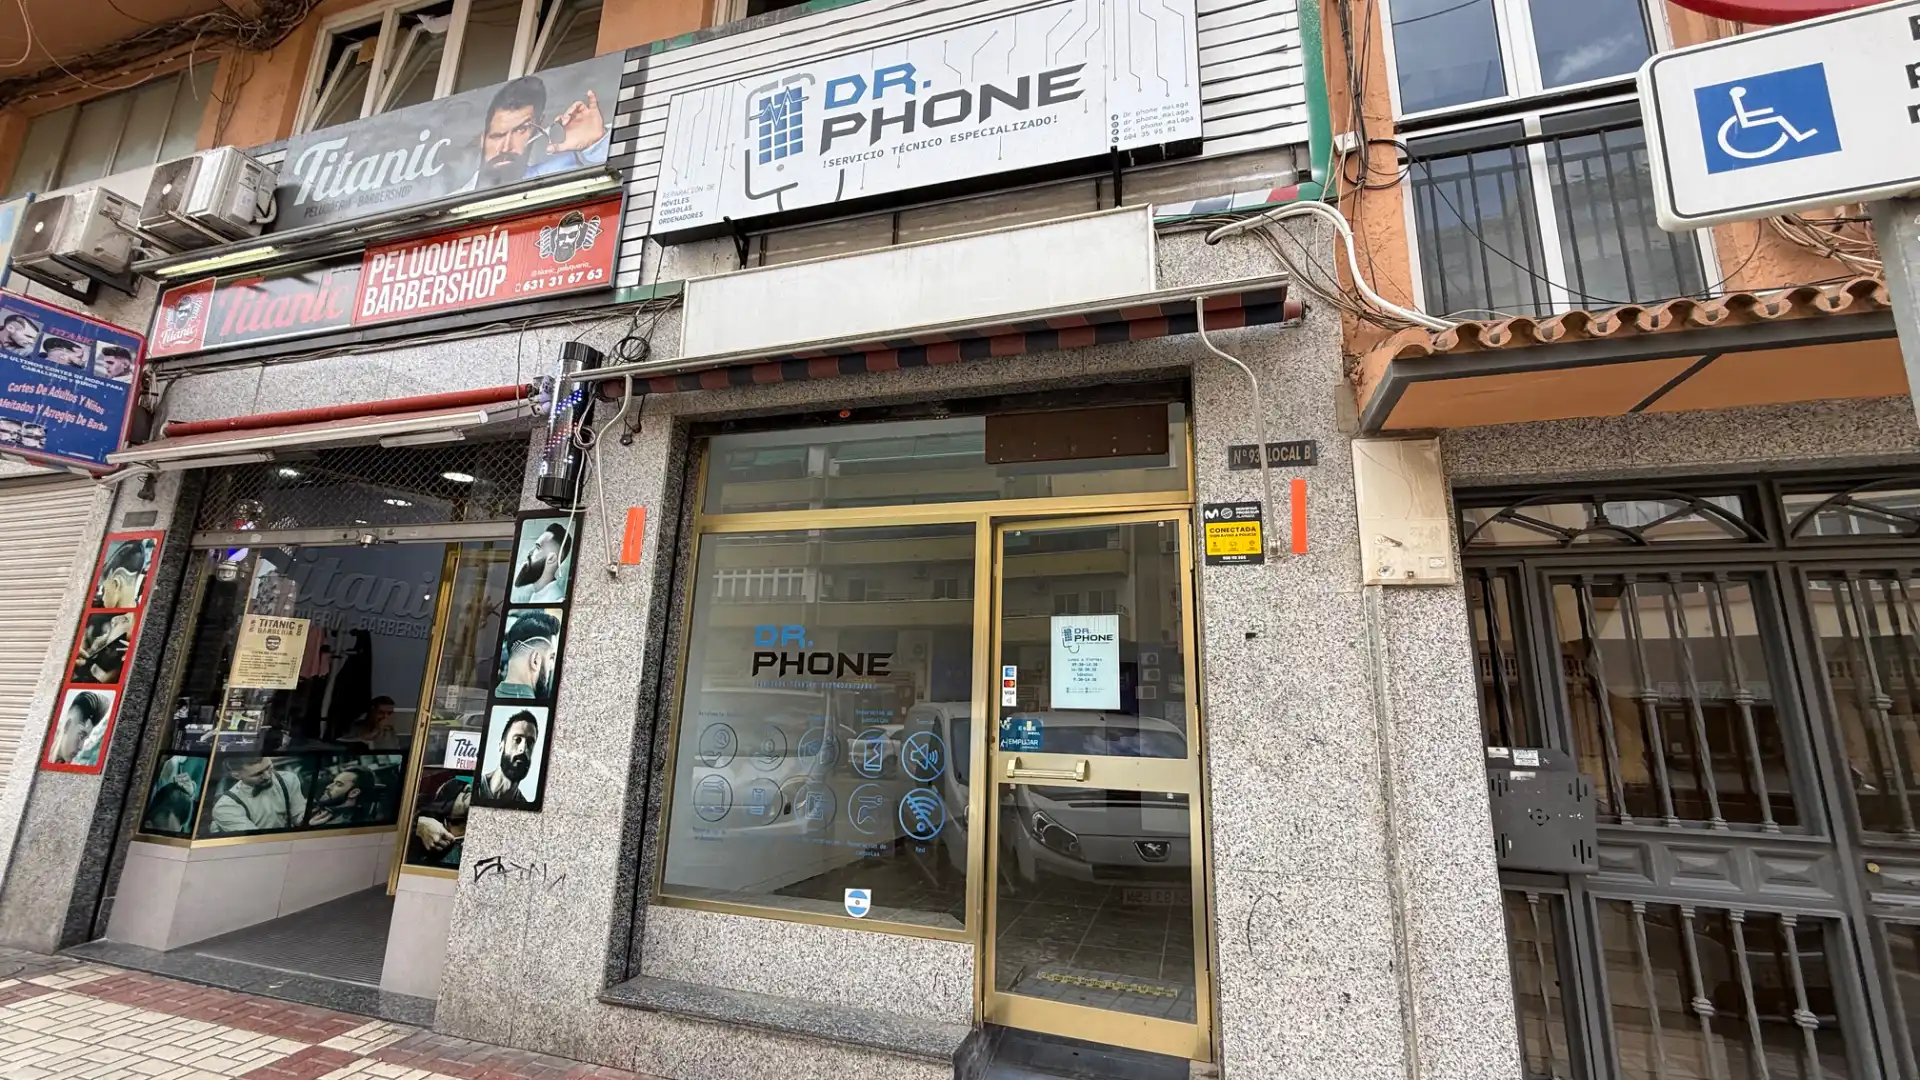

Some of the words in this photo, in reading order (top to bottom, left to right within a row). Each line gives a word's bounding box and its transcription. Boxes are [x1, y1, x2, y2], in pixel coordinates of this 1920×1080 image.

[824, 62, 931, 110] DR.
[819, 62, 1087, 156] PHONE
[892, 135, 943, 155] TÉCNICO
[949, 115, 1058, 143] ESPECIALIZADO!
[293, 128, 452, 207] Titanic
[357, 184, 414, 209] BARBERSHOP
[661, 196, 690, 208] MÓVILES
[662, 185, 704, 200] REPARACIÓN
[707, 183, 716, 191] DE
[658, 210, 704, 226] ORDENADORES
[660, 204, 693, 217] CONSOLAS
[367, 225, 509, 287] PELUQUERÍA
[361, 264, 508, 317] BARBERSHOP
[522, 278, 545, 292] 631
[548, 275, 564, 288] 31
[567, 271, 585, 284] 67
[586, 268, 603, 281] 63
[219, 275, 350, 337] Titanic
[50, 327, 95, 346] TITANIC
[7, 382, 35, 394] Cortes
[35, 383, 48, 395] De
[47, 386, 79, 404] Adultos
[78, 394, 87, 406] Y
[84, 398, 105, 416] Niños
[36, 403, 44, 415] Y
[75, 412, 87, 426] De
[1267, 445, 1302, 463] LOCAL
[1304, 445, 1311, 460] B
[1209, 526, 1257, 534] CONECTADA
[259, 618, 296, 629] TITANIC
[754, 624, 815, 649] DR.
[1074, 634, 1114, 642] PHONE
[752, 651, 894, 679] PHONE
[454, 738, 478, 758] Tita
[1008, 738, 1039, 746] EMPUJAR
